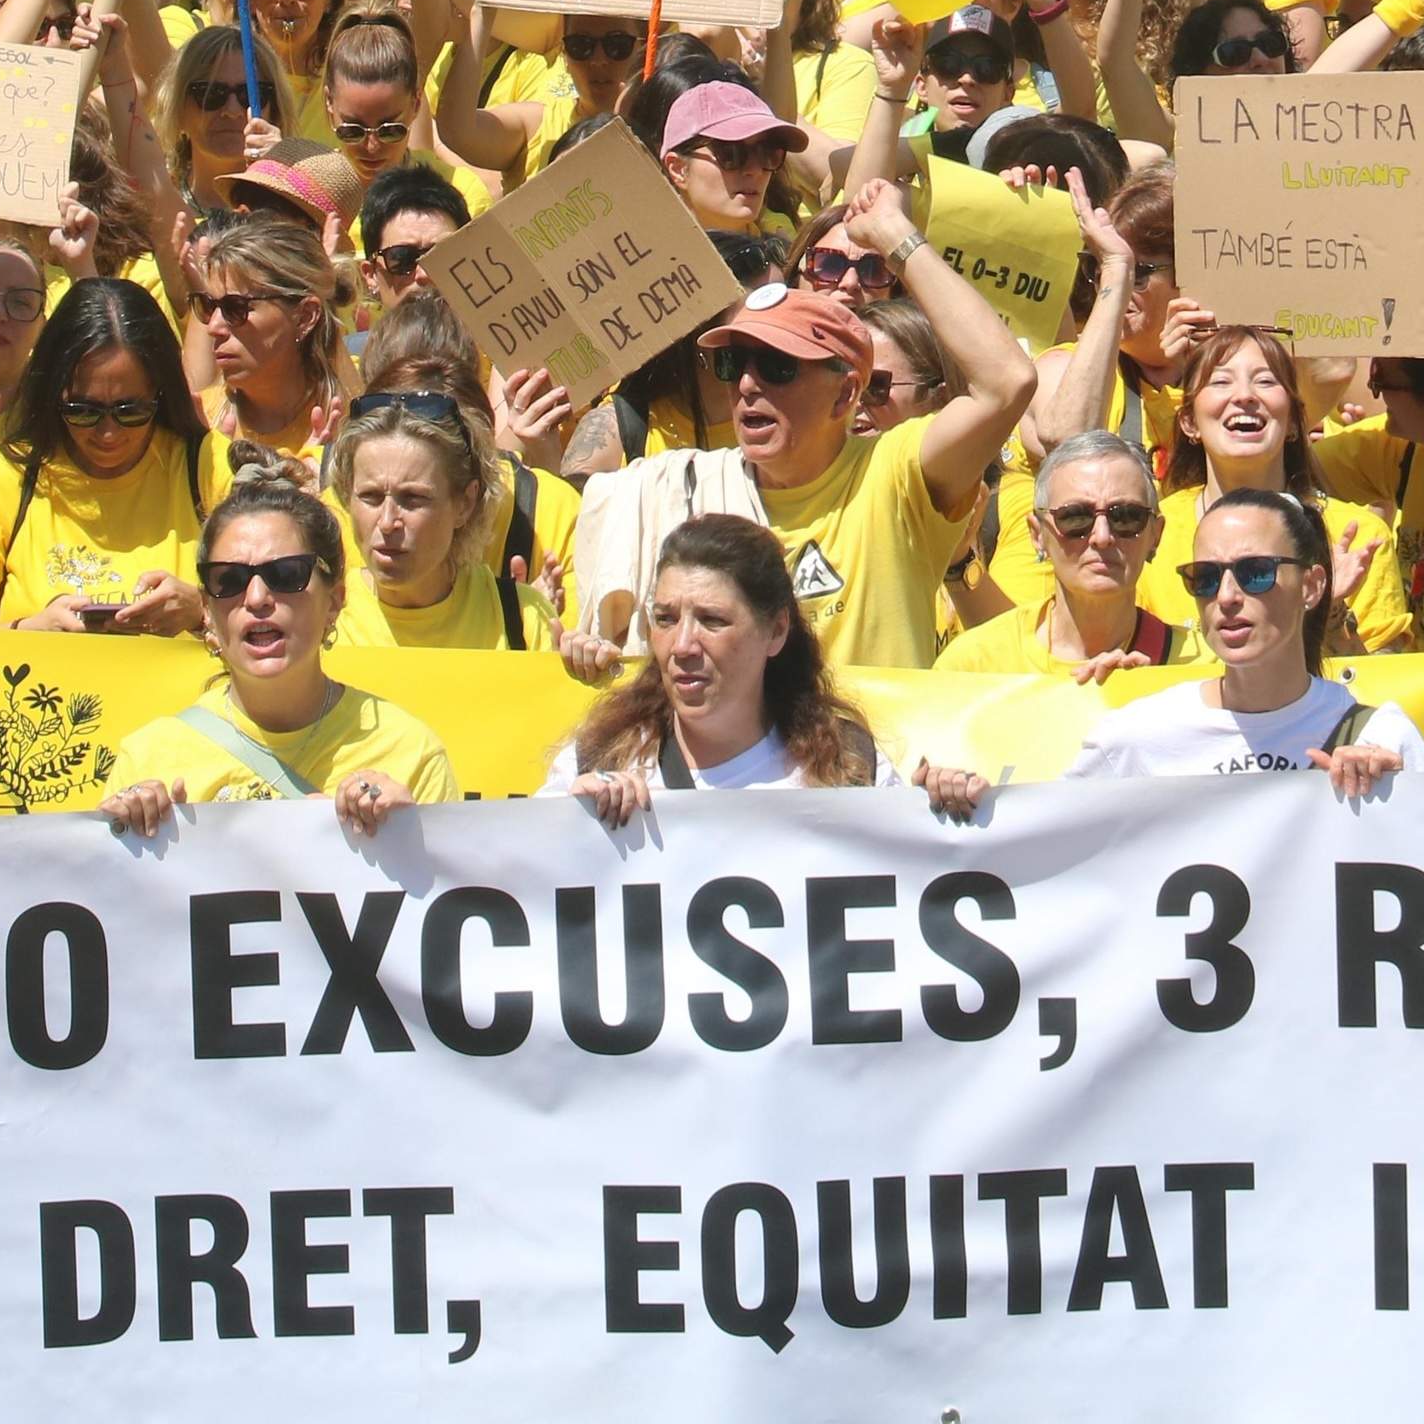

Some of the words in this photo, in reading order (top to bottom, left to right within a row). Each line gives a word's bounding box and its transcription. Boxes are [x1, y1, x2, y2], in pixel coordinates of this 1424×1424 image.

[1197, 96, 1260, 144] LA
[1275, 102, 1416, 144] MESTRA
[943, 246, 969, 276] EL
[971, 258, 1009, 289] 0-3
[1015, 270, 1052, 303] DIU
[1192, 221, 1293, 270] TAMBÉ
[1306, 233, 1368, 270] ESTÀ
[600, 308, 642, 351] DE
[640, 257, 703, 326] DEMÀ
[5, 901, 109, 1072] 0
[189, 871, 1078, 1072] EXCUSES,
[1155, 861, 1256, 1033] 3
[39, 1185, 482, 1365] DRET,
[602, 1162, 1255, 1354] EQUITAT
[1373, 1162, 1409, 1311] I
